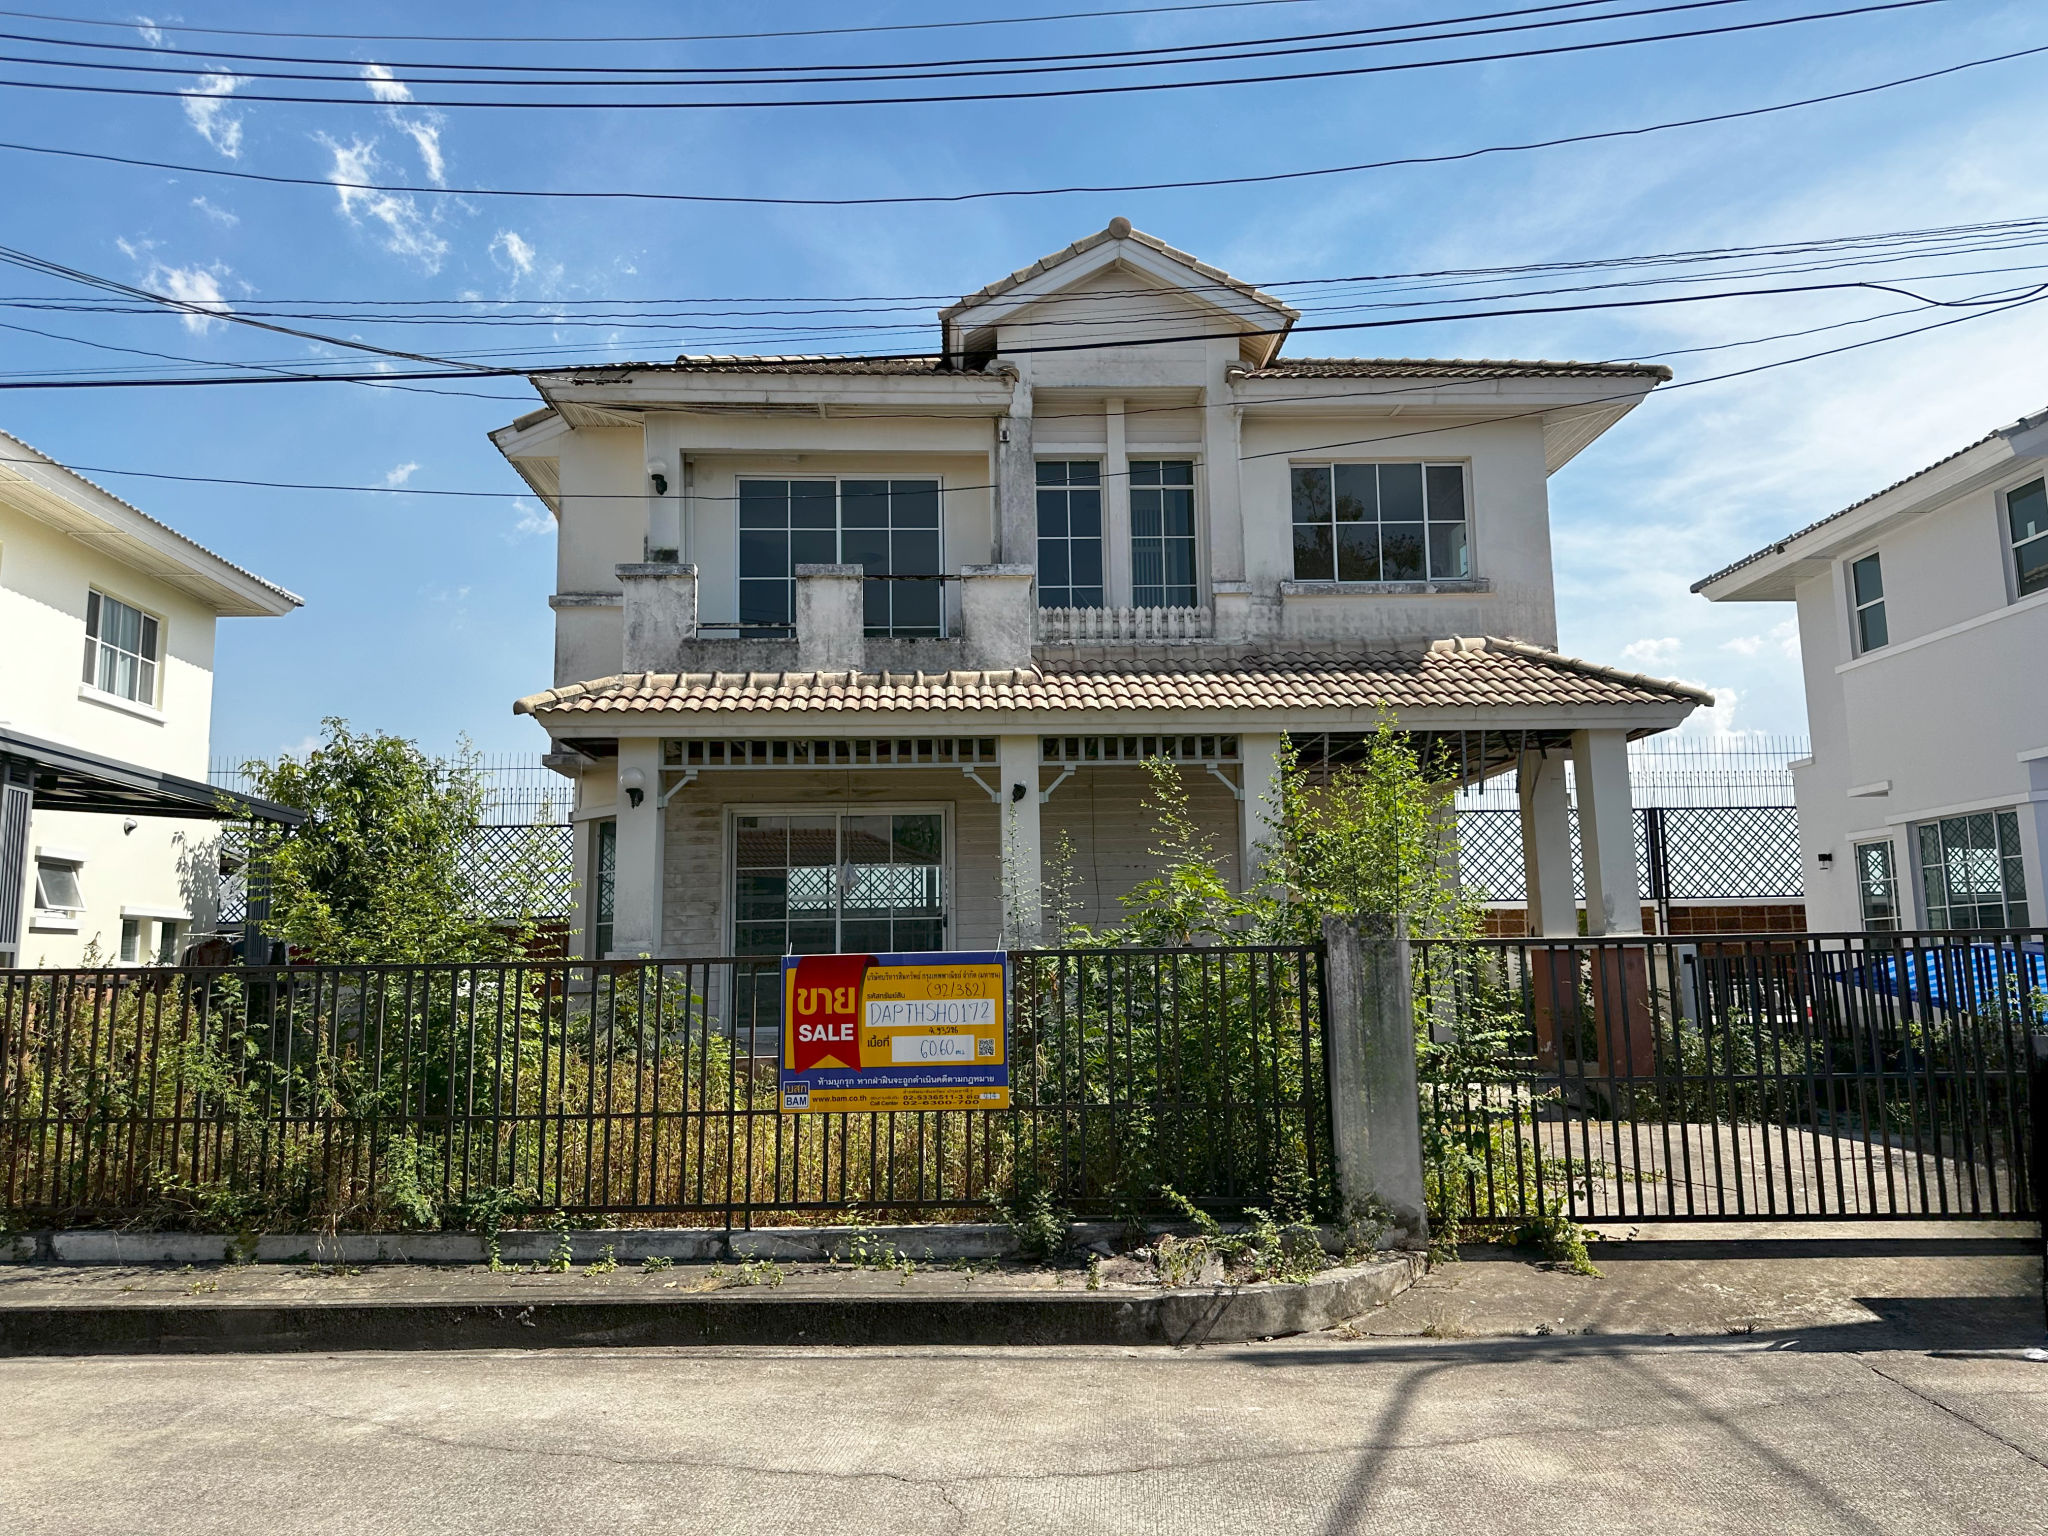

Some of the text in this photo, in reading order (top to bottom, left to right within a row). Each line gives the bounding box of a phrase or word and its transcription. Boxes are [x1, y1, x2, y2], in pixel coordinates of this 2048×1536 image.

[926, 981, 986, 998] (92/382)
[797, 987, 856, 1015] ขาย
[798, 1023, 854, 1042] SALE
[867, 1034, 890, 1048] เนื้อที่
[818, 1077, 854, 1088] ห้ามบุกรุก
[786, 1096, 807, 1106] BAM
[812, 1095, 867, 1103] www.bam.co.th
